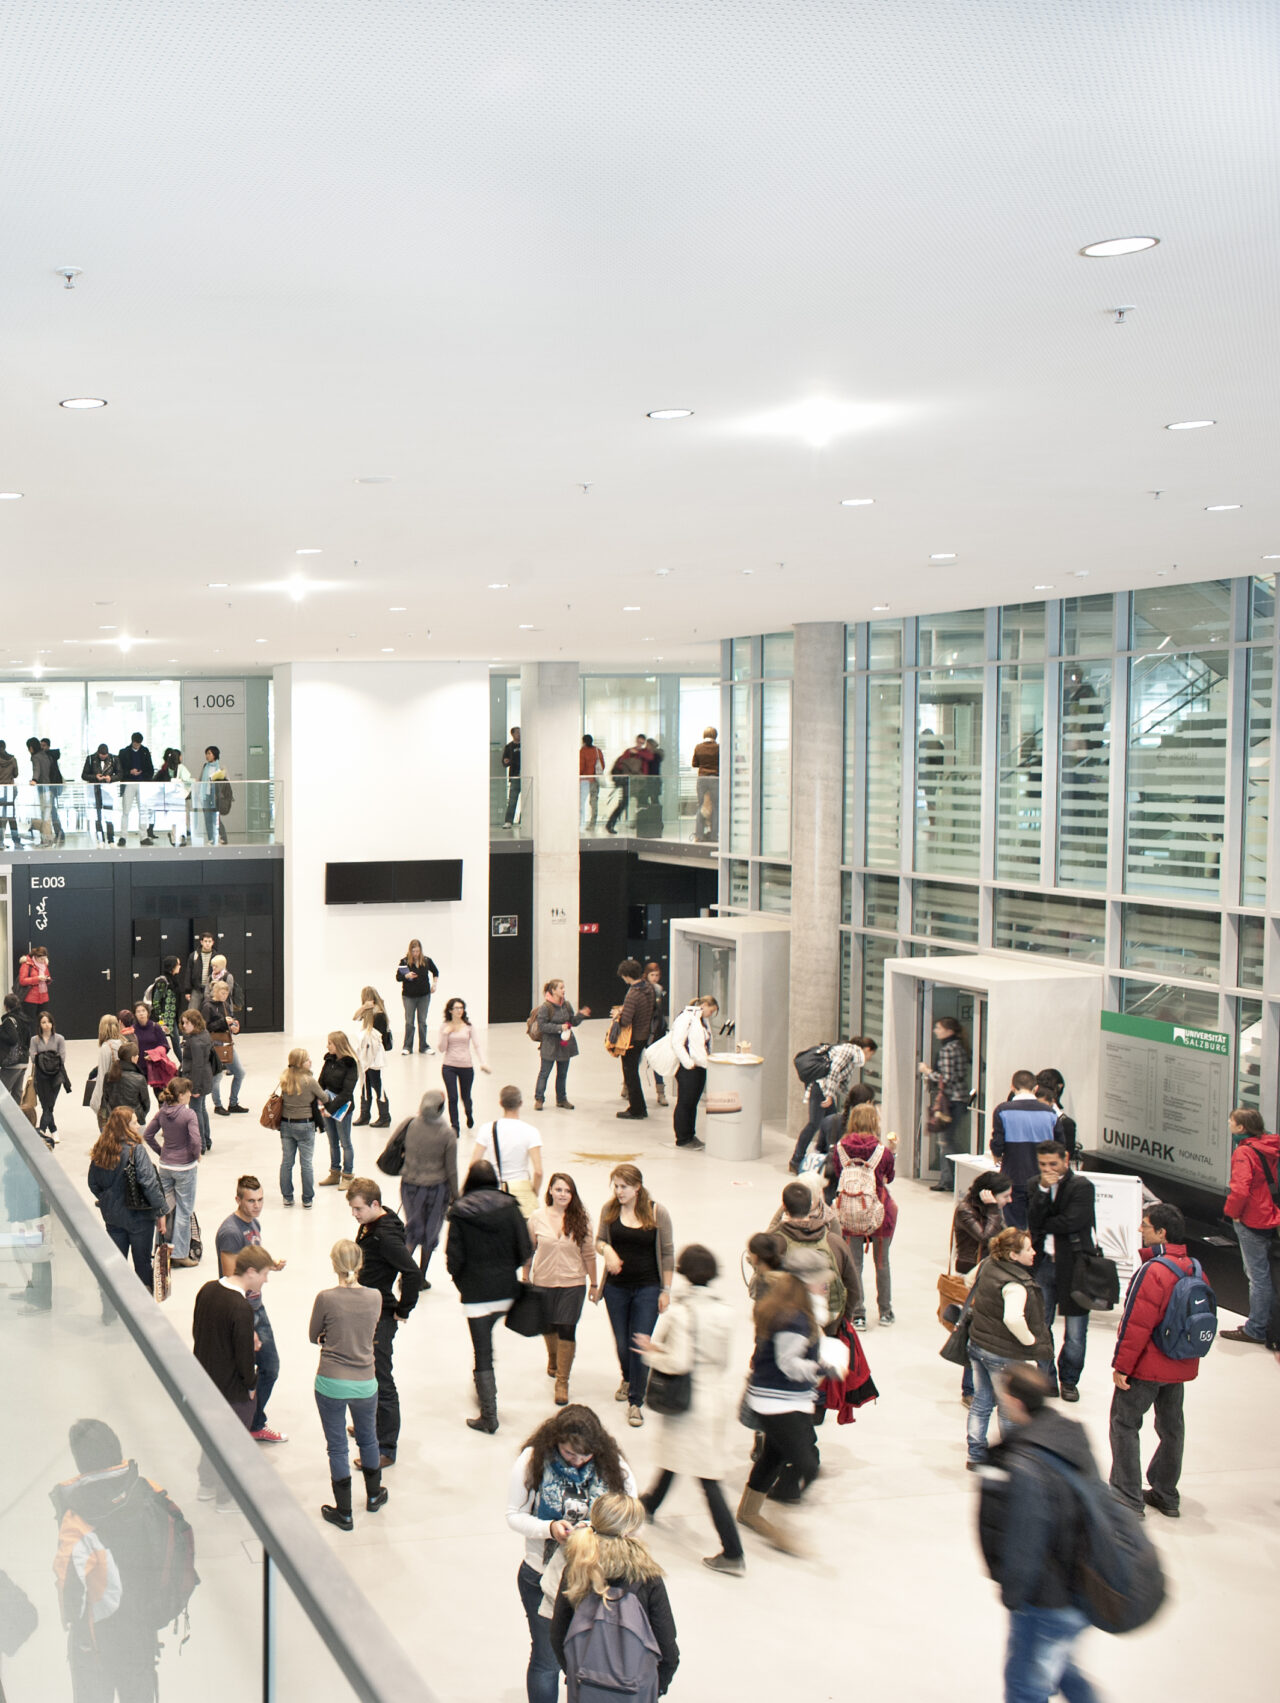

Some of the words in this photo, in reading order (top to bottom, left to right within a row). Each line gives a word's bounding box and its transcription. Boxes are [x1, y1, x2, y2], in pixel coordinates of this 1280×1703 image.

[193, 694, 235, 708] 1.006
[31, 876, 65, 888] E.003
[1184, 1030, 1226, 1044] UNIVERSITÄT
[1184, 1038, 1227, 1053] SALZBURG
[1103, 1127, 1175, 1162] UNIPARK
[1179, 1149, 1213, 1166] NONNTAL
